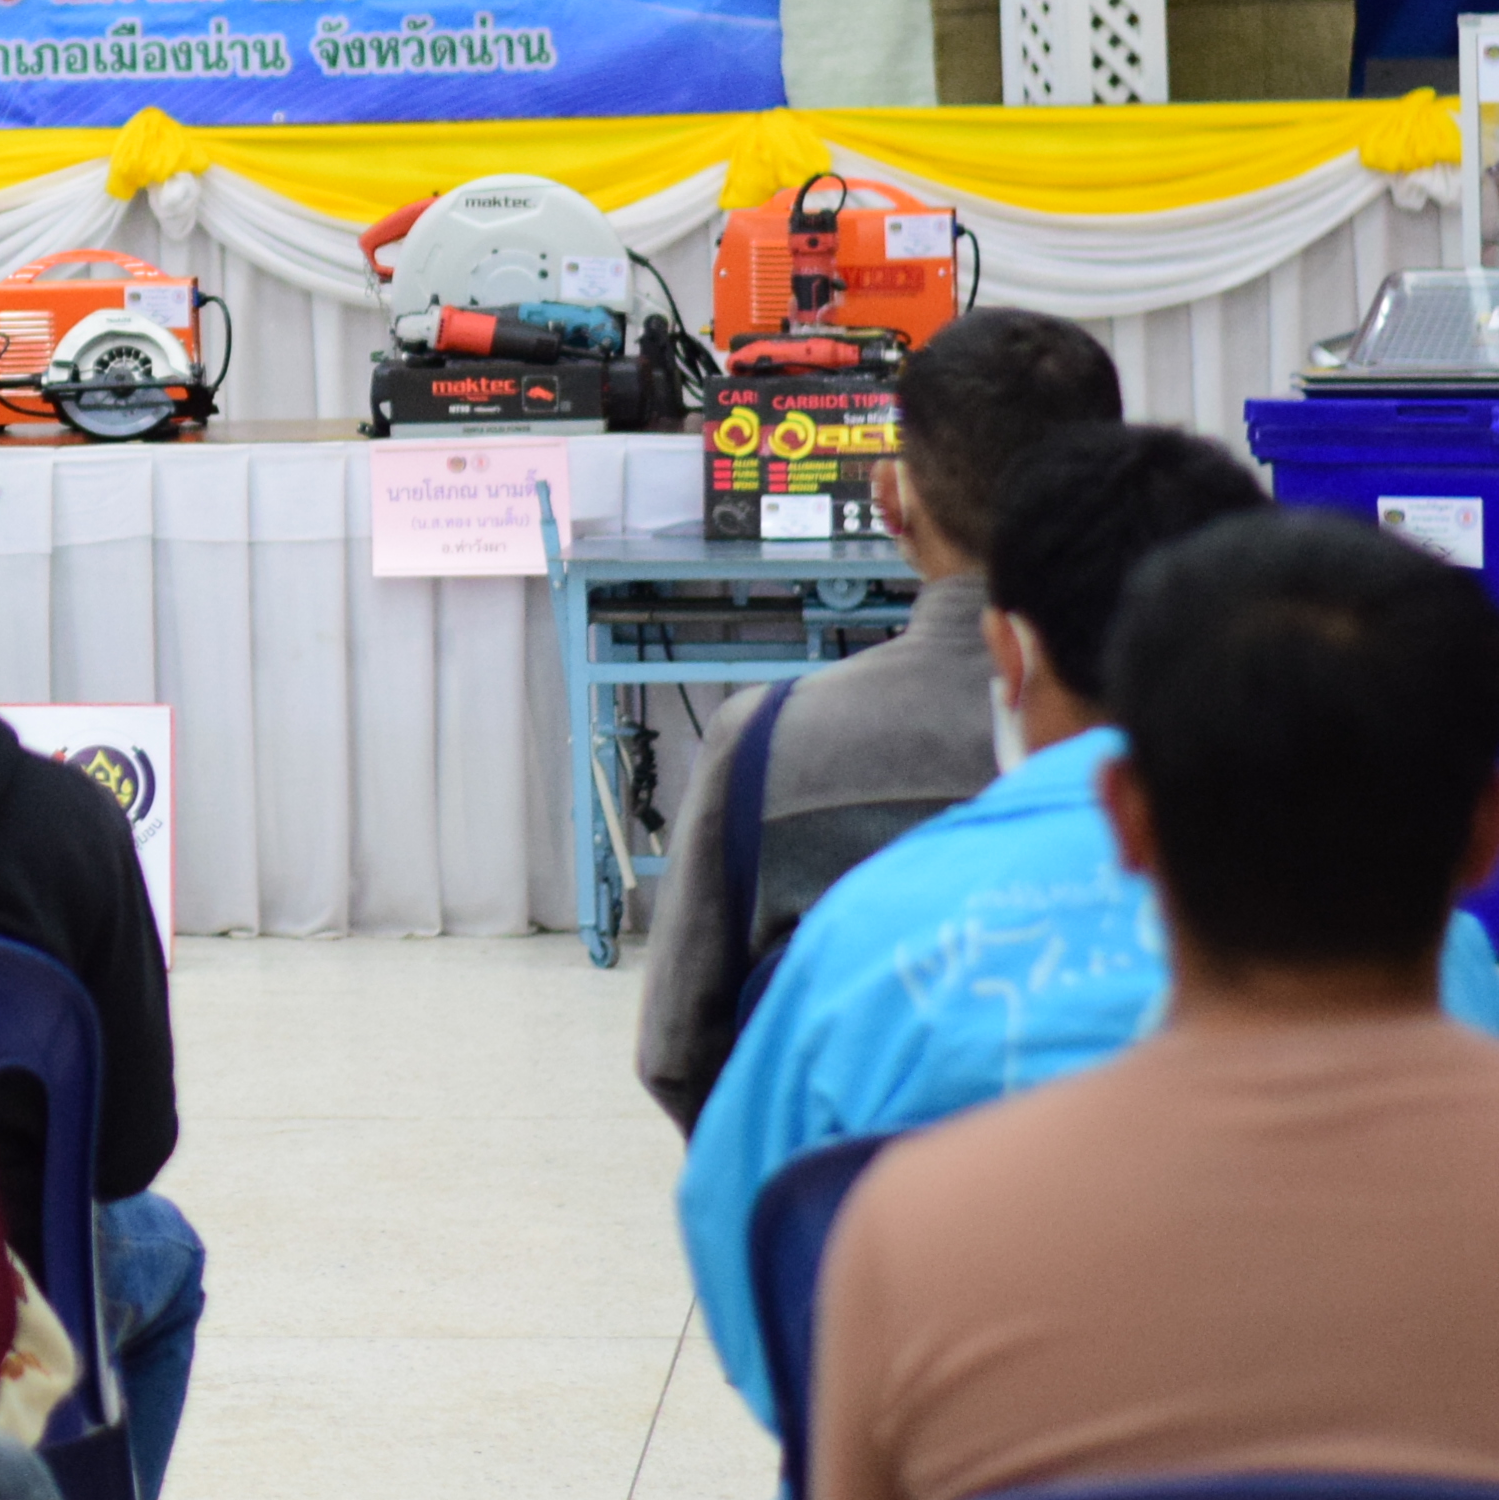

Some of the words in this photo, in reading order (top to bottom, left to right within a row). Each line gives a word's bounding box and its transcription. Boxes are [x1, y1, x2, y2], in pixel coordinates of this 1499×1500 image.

[315, 12, 553, 71] จังหวัดน่าน
[431, 376, 520, 397] maktec
[771, 393, 849, 411] CARBIDE
